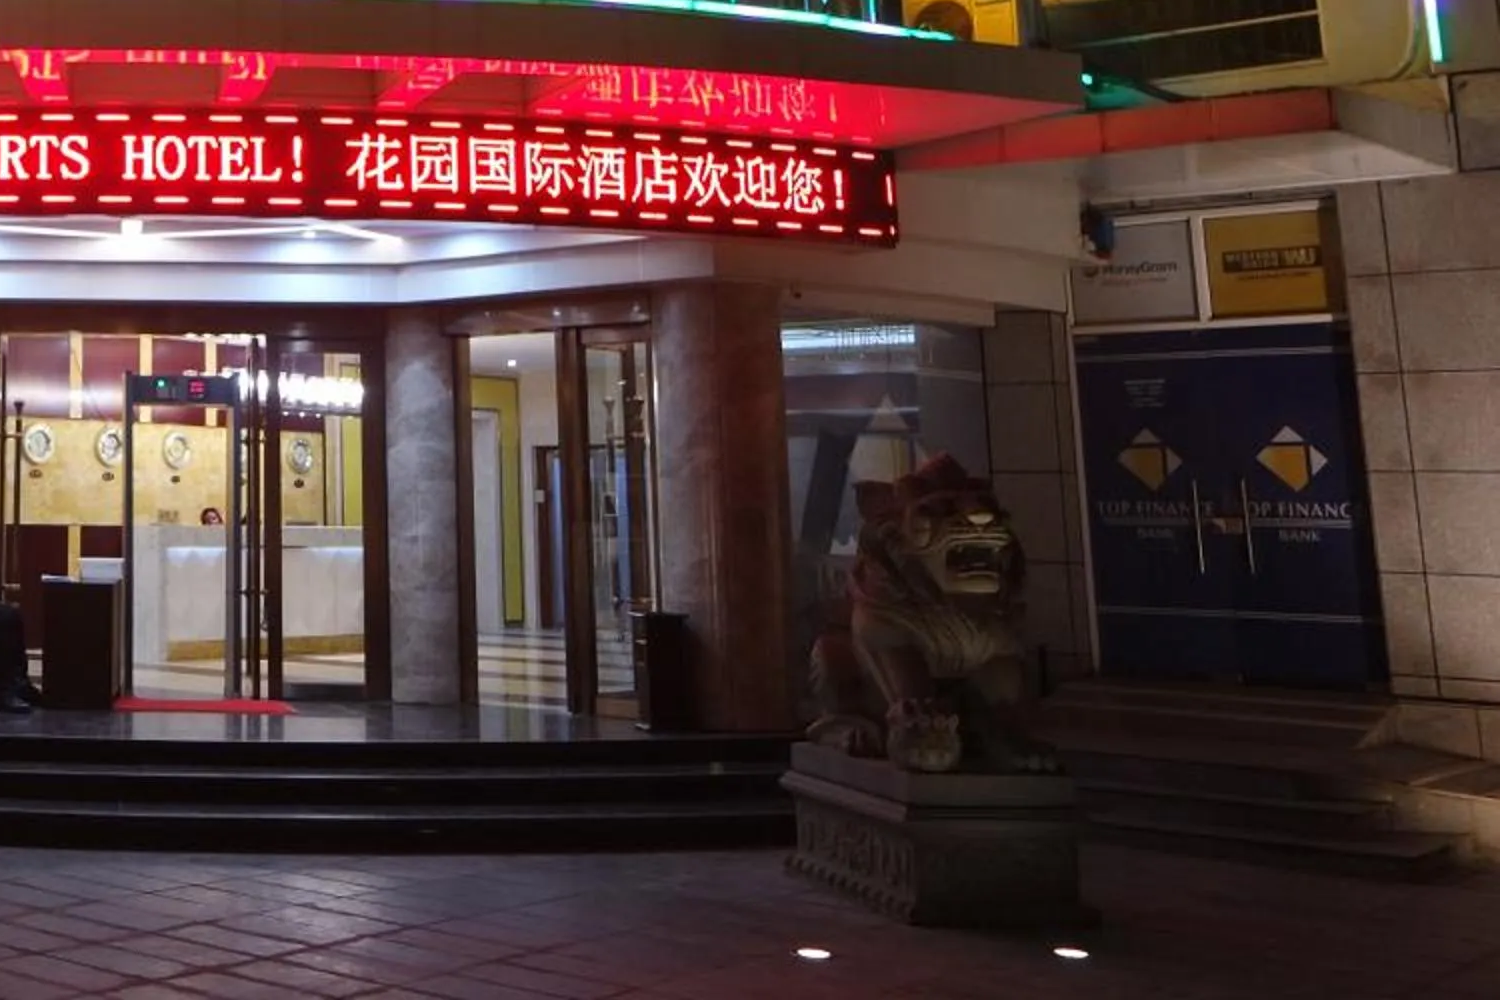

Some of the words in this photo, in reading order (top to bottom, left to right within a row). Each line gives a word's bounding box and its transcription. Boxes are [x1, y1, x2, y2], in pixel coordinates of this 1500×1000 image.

[121, 135, 303, 183] HOTEL!
[345, 131, 848, 214] 花园国际酒店欢迎您!
[1279, 529, 1321, 542] BANK
